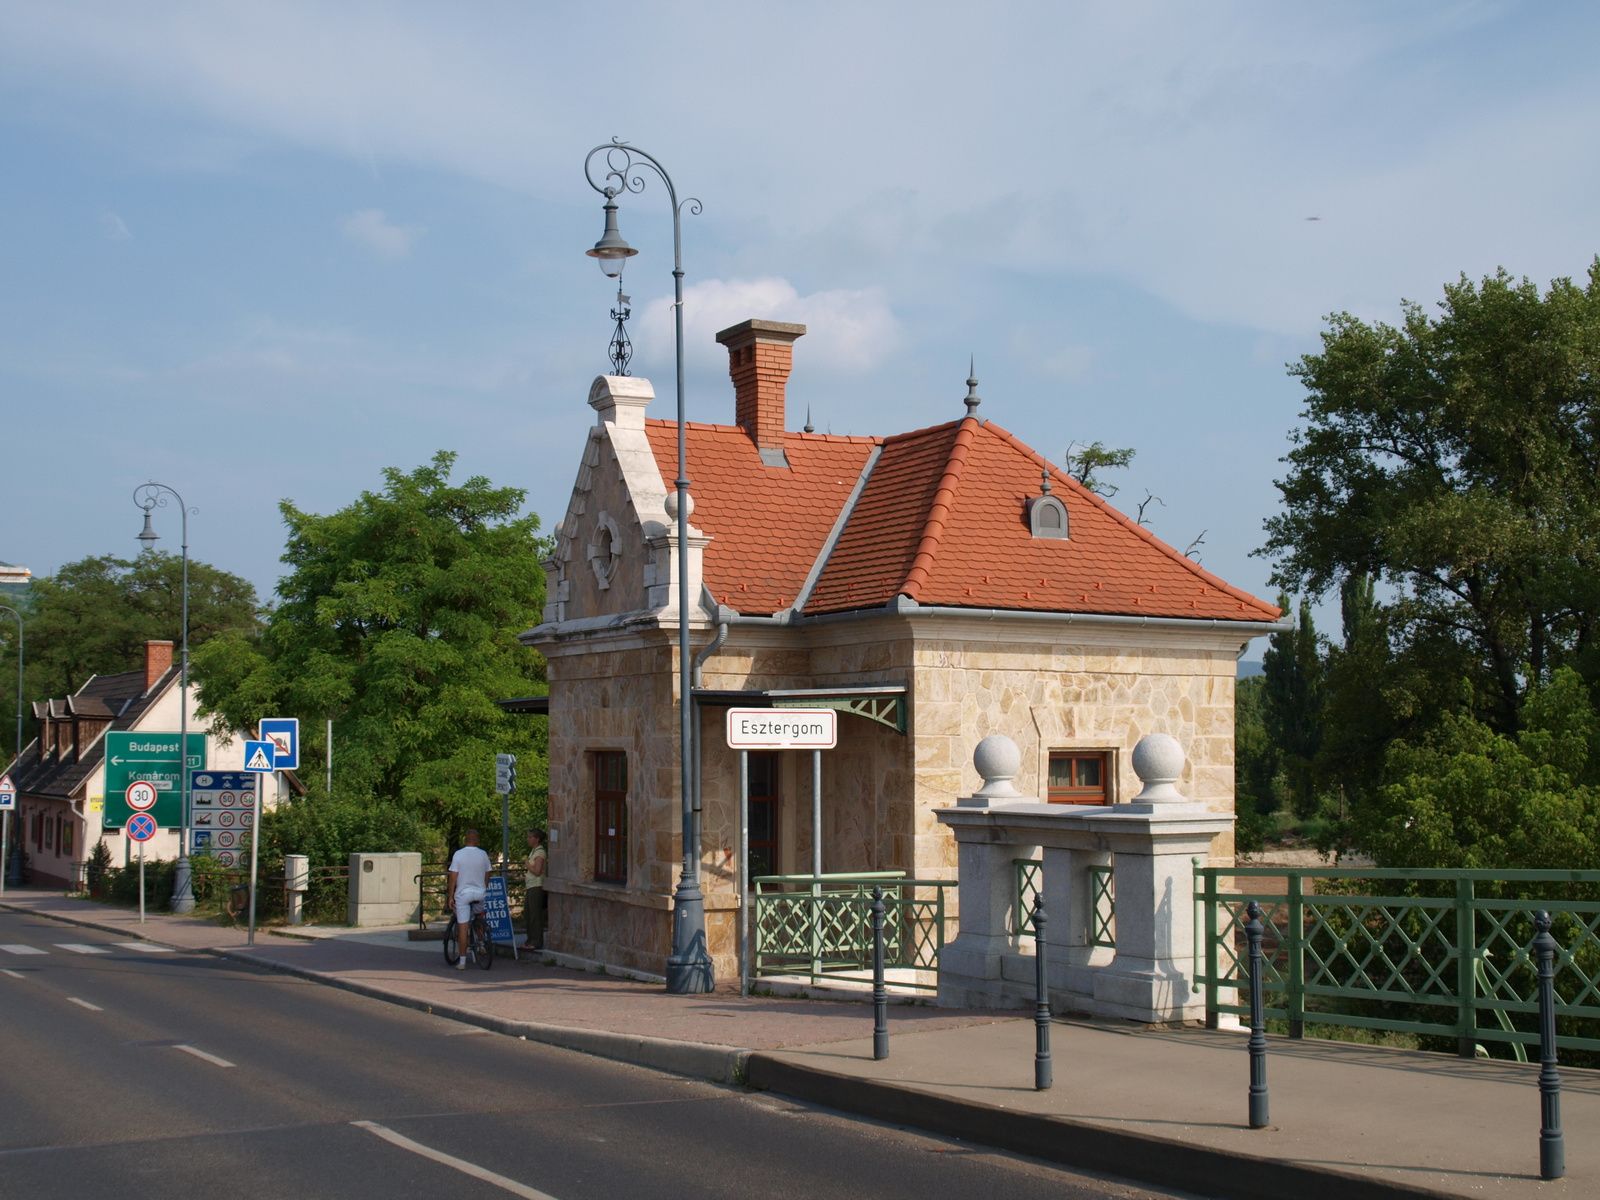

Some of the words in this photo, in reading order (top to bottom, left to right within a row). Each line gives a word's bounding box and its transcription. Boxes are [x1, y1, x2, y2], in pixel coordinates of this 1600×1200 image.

[741, 720, 823, 738] Esztergom
[129, 742, 179, 754] Budapest
[128, 770, 180, 780] Komárom
[2, 795, 10, 803] P
[134, 790, 148, 801] 30
[222, 795, 233, 803] 50
[483, 899, 505, 910] ETÉS
[486, 909, 507, 919] ÁLTÓ
